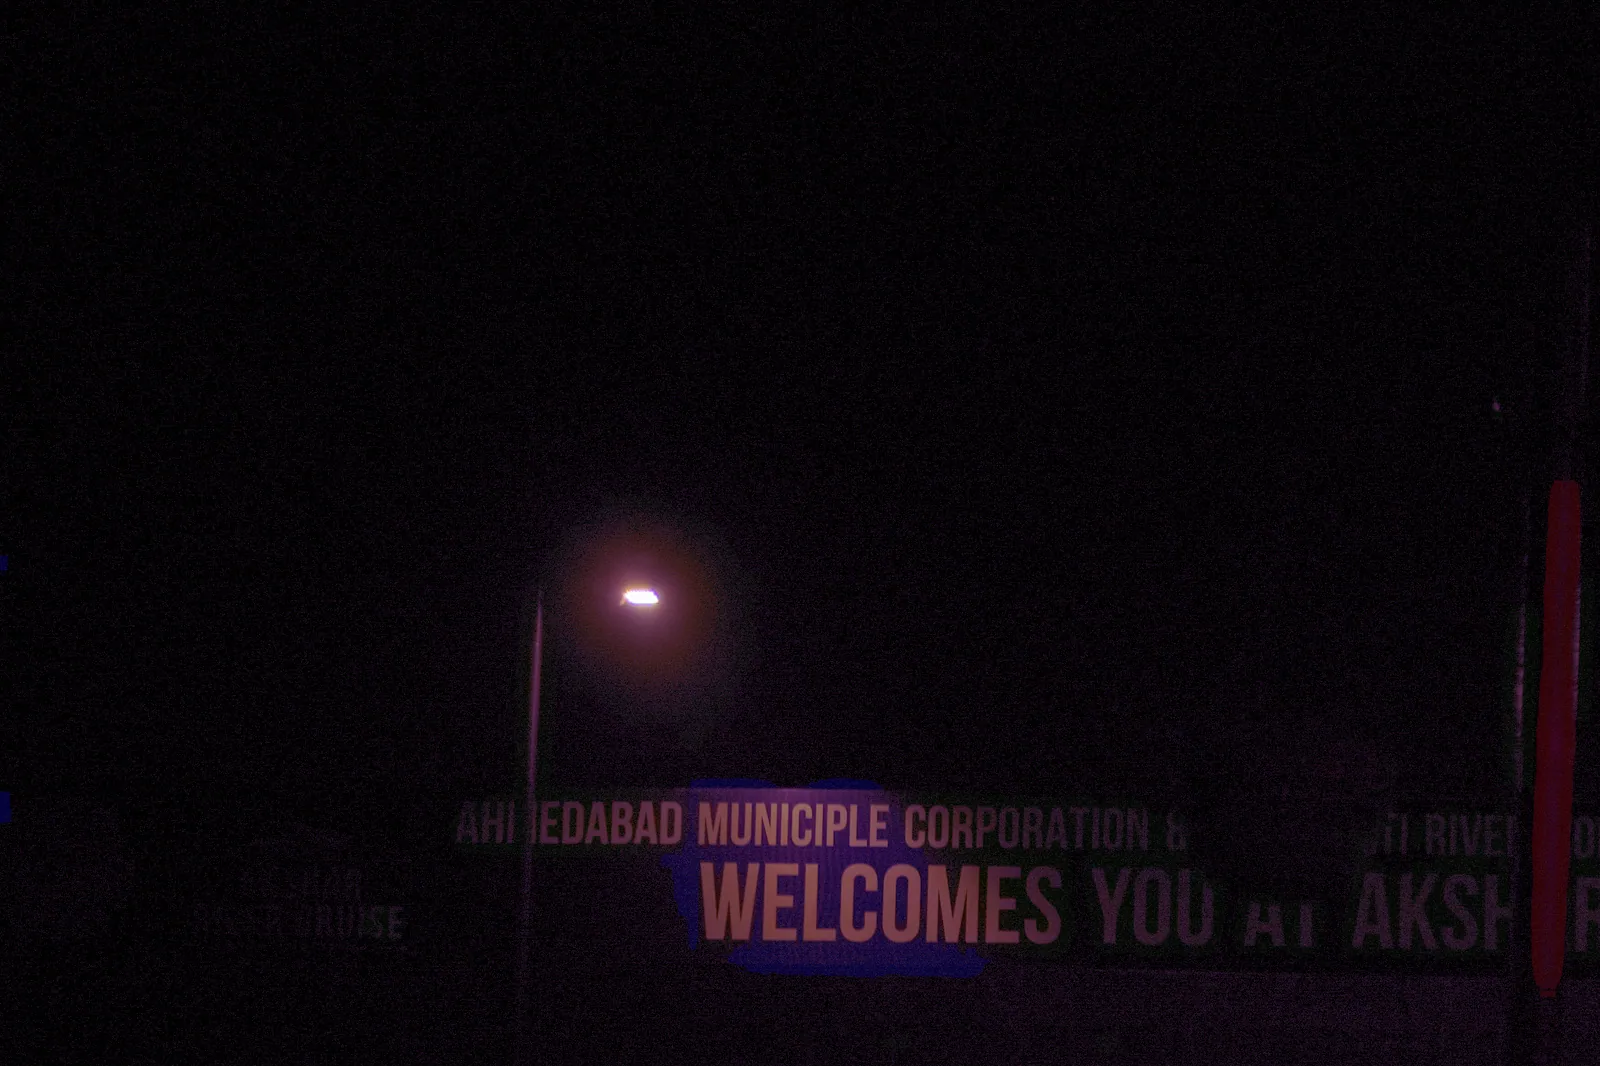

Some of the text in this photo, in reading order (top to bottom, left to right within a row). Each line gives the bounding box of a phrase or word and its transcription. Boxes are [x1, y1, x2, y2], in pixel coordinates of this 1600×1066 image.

[698, 801, 890, 848] MUNICIPLE
[904, 804, 1149, 853] CORPORATION
[700, 861, 1063, 945] WELCOMES
[1091, 866, 1214, 947] YOU
